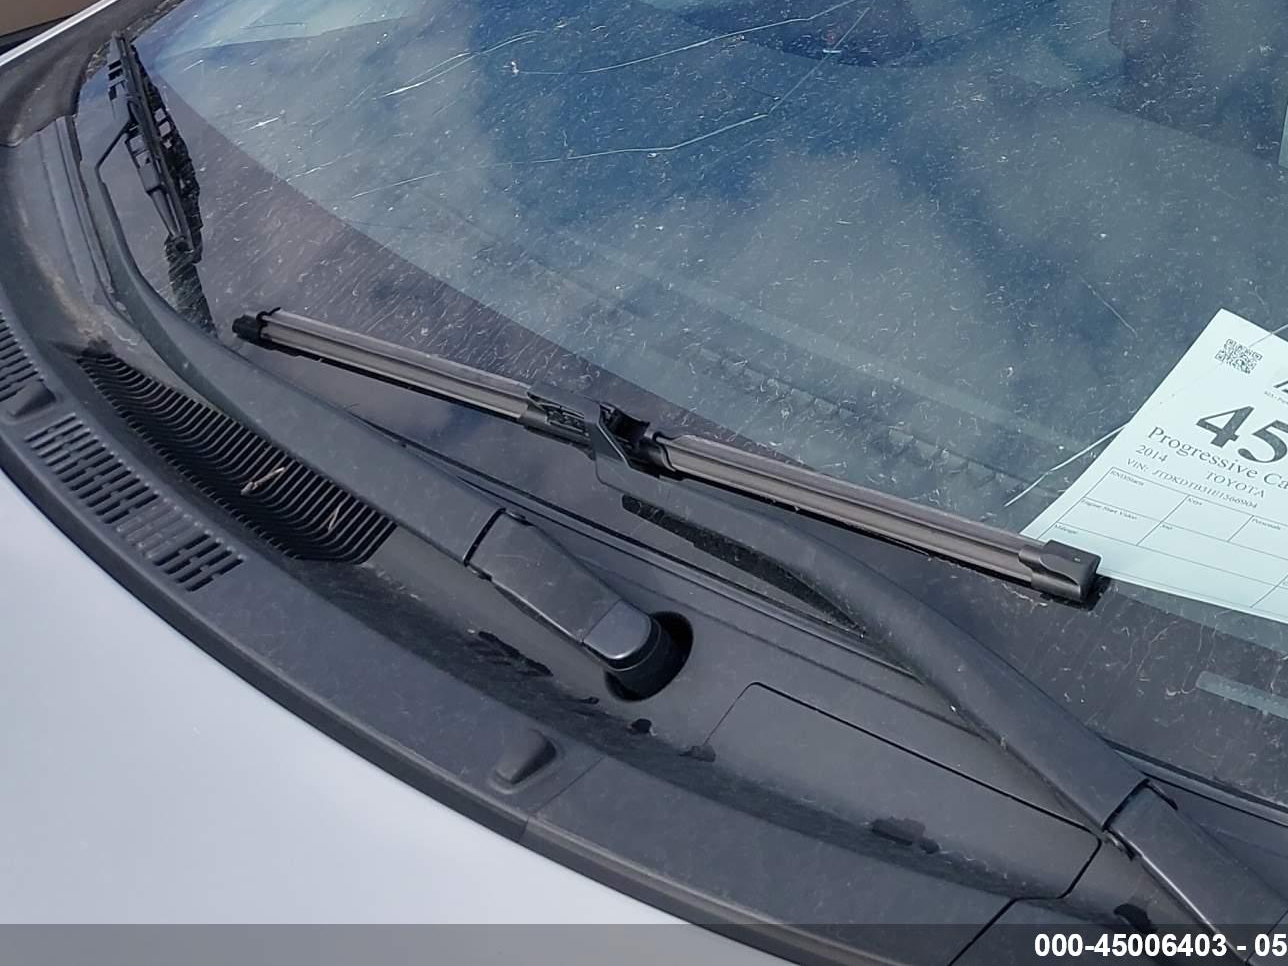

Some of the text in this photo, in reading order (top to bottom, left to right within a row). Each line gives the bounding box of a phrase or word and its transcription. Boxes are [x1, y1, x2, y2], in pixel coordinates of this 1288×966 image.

[1126, 458, 1149, 473] VIN:
[1135, 444, 1169, 463] 2014
[1205, 470, 1265, 498] TOYOTA
[1147, 426, 1258, 479] Progressive
